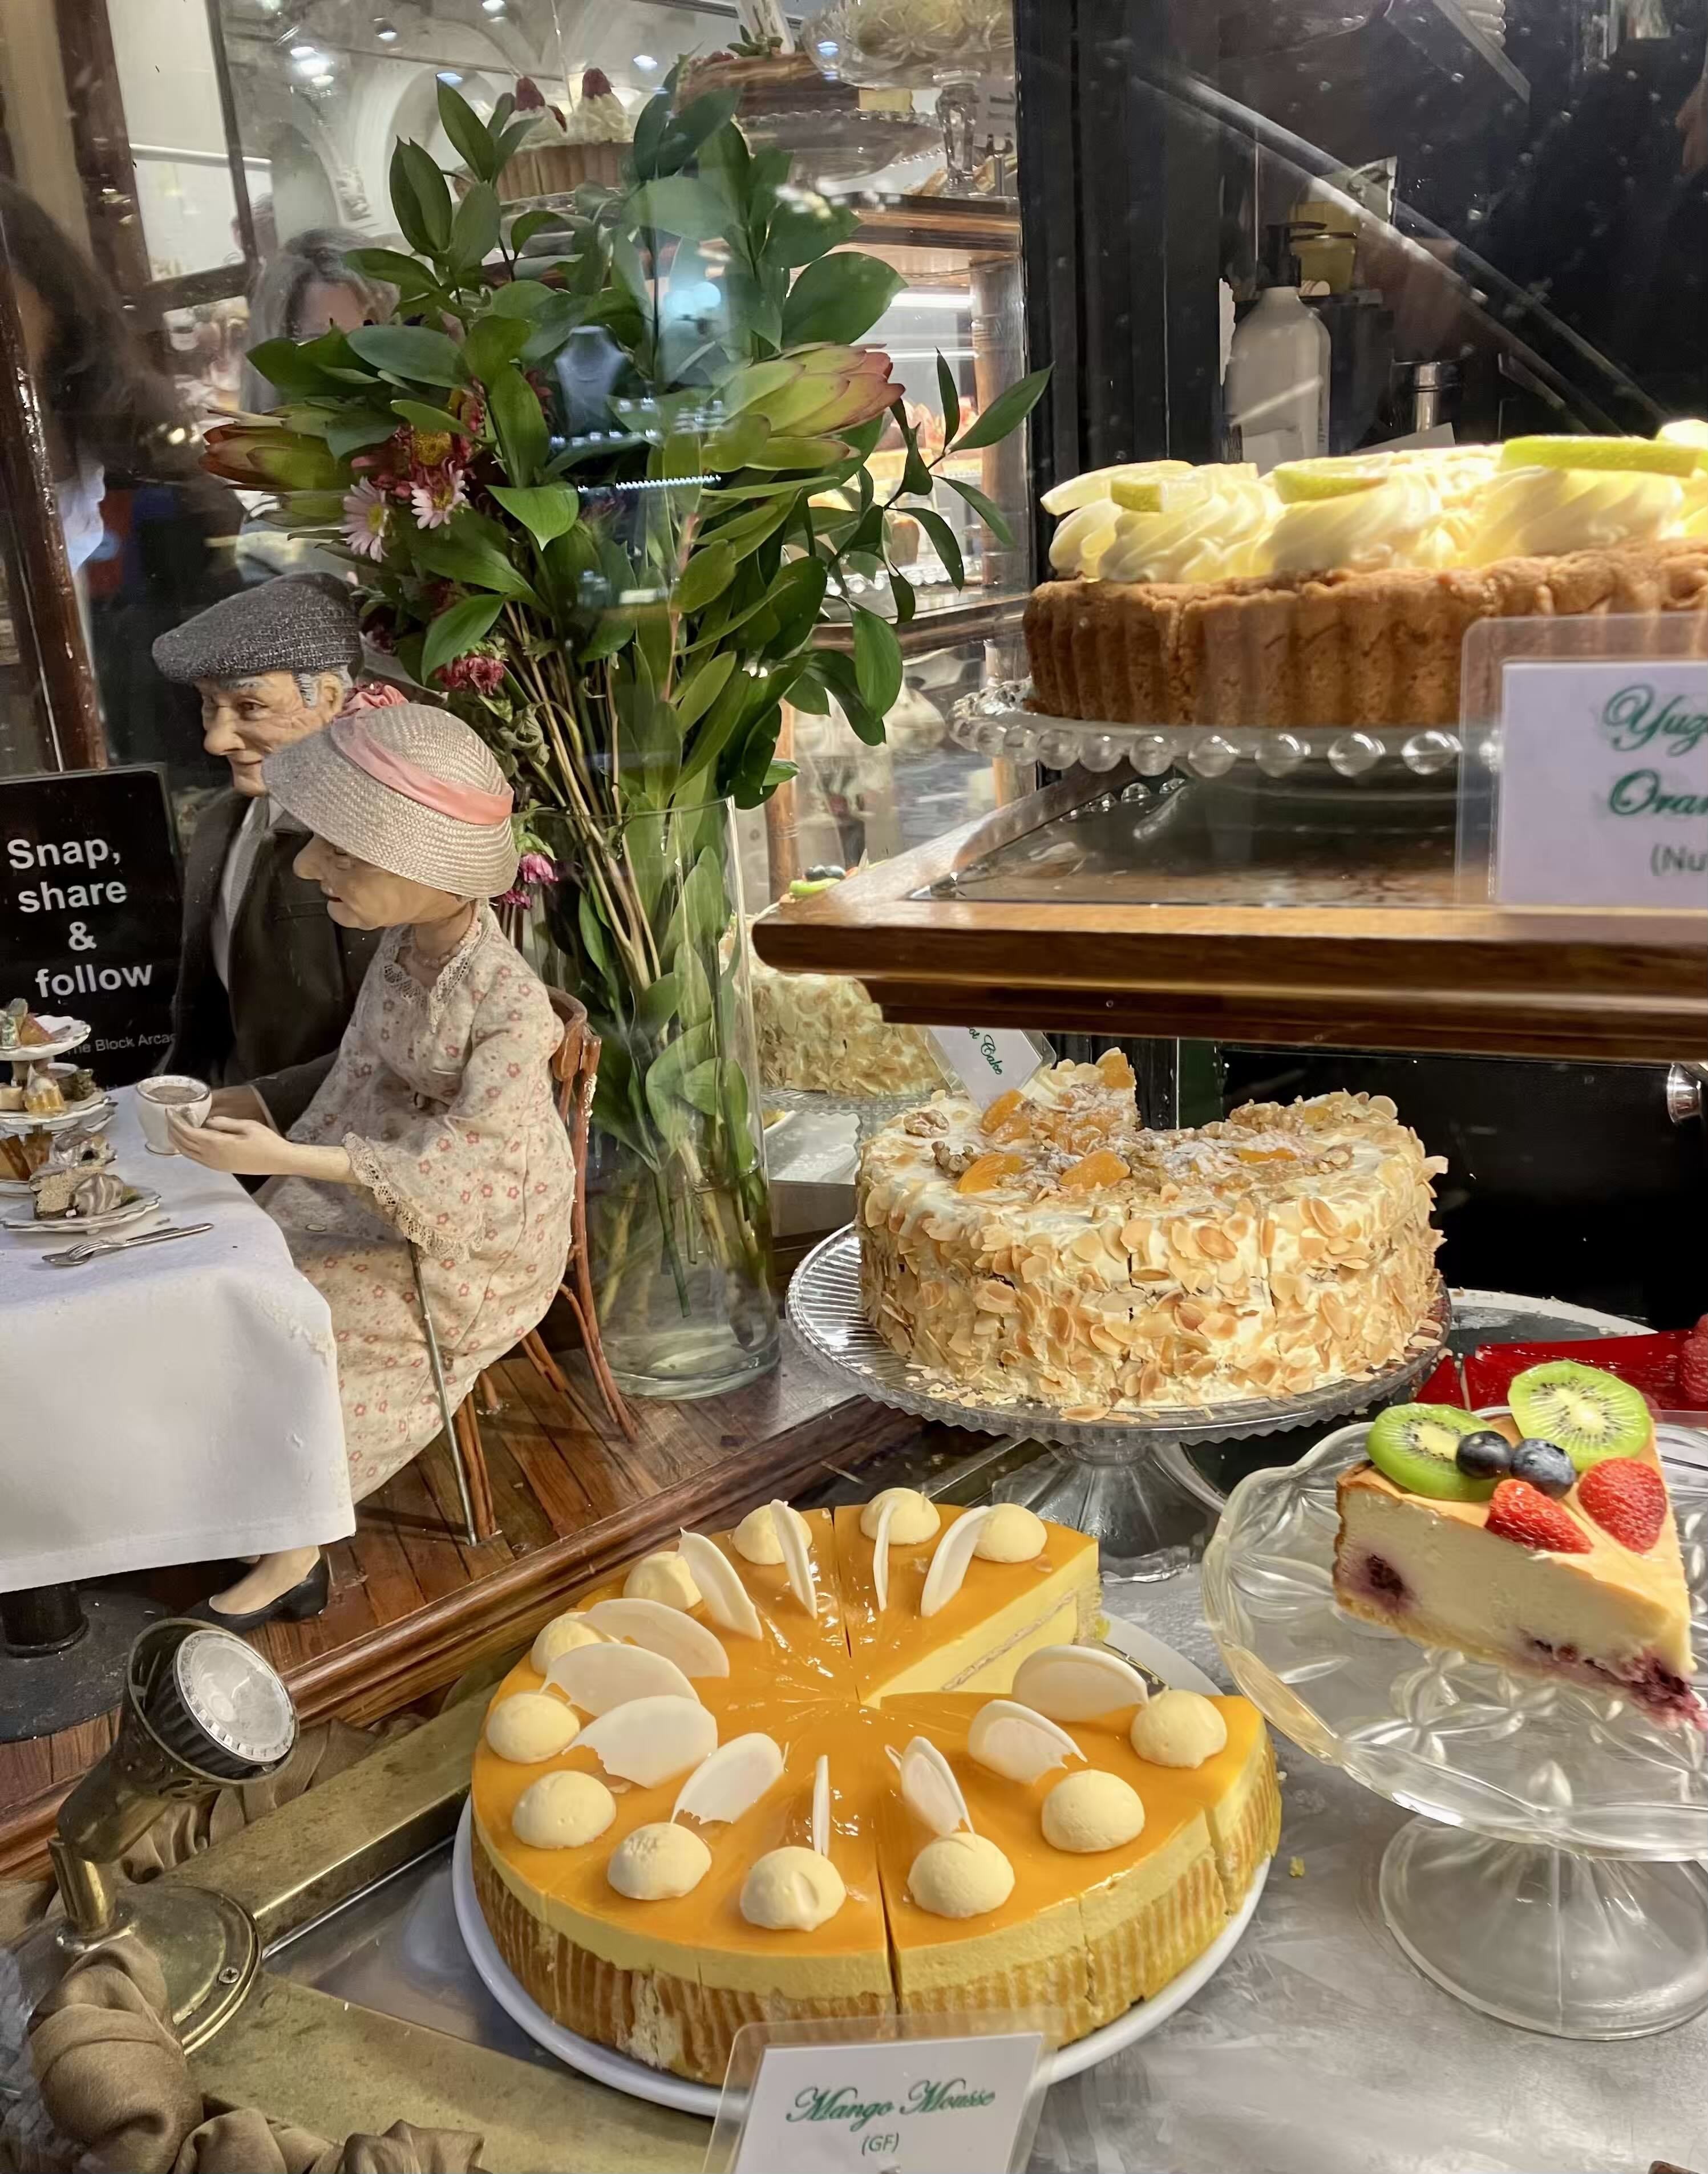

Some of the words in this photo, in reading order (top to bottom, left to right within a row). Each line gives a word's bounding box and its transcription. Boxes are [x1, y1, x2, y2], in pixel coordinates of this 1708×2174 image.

[7, 838, 120, 870] Snap,
[18, 880, 128, 913] share
[68, 921, 98, 951] &
[34, 964, 153, 998] follow
[95, 1037, 135, 1051] Block
[981, 1034, 1003, 1075] Cake
[786, 2085, 895, 2132] Mango
[899, 2077, 995, 2115] Mousse
[861, 2132, 900, 2156] (GF)
